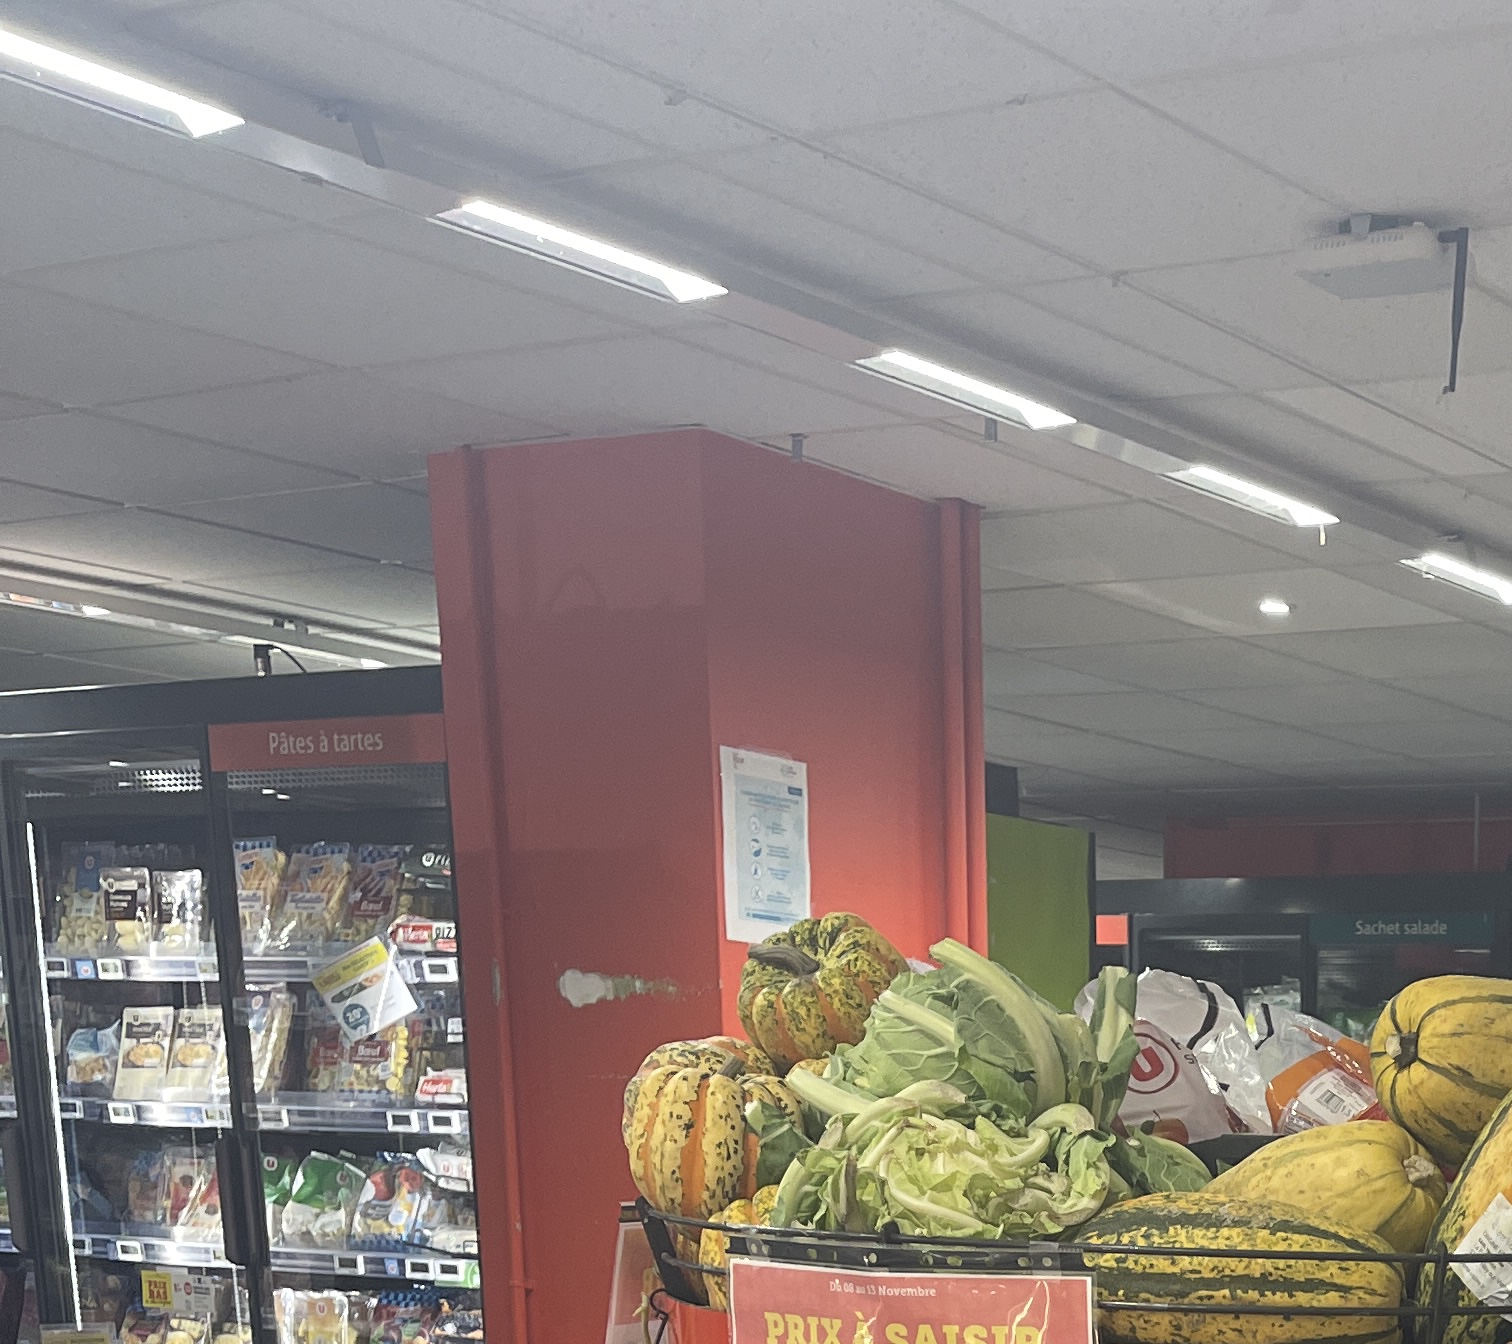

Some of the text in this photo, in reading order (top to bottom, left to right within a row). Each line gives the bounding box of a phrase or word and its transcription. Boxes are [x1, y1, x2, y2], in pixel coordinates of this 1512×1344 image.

[269, 730, 383, 755] Pâtes à tartes
[1355, 920, 1448, 935] Sachet salade
[878, 1285, 937, 1298] Novembre
